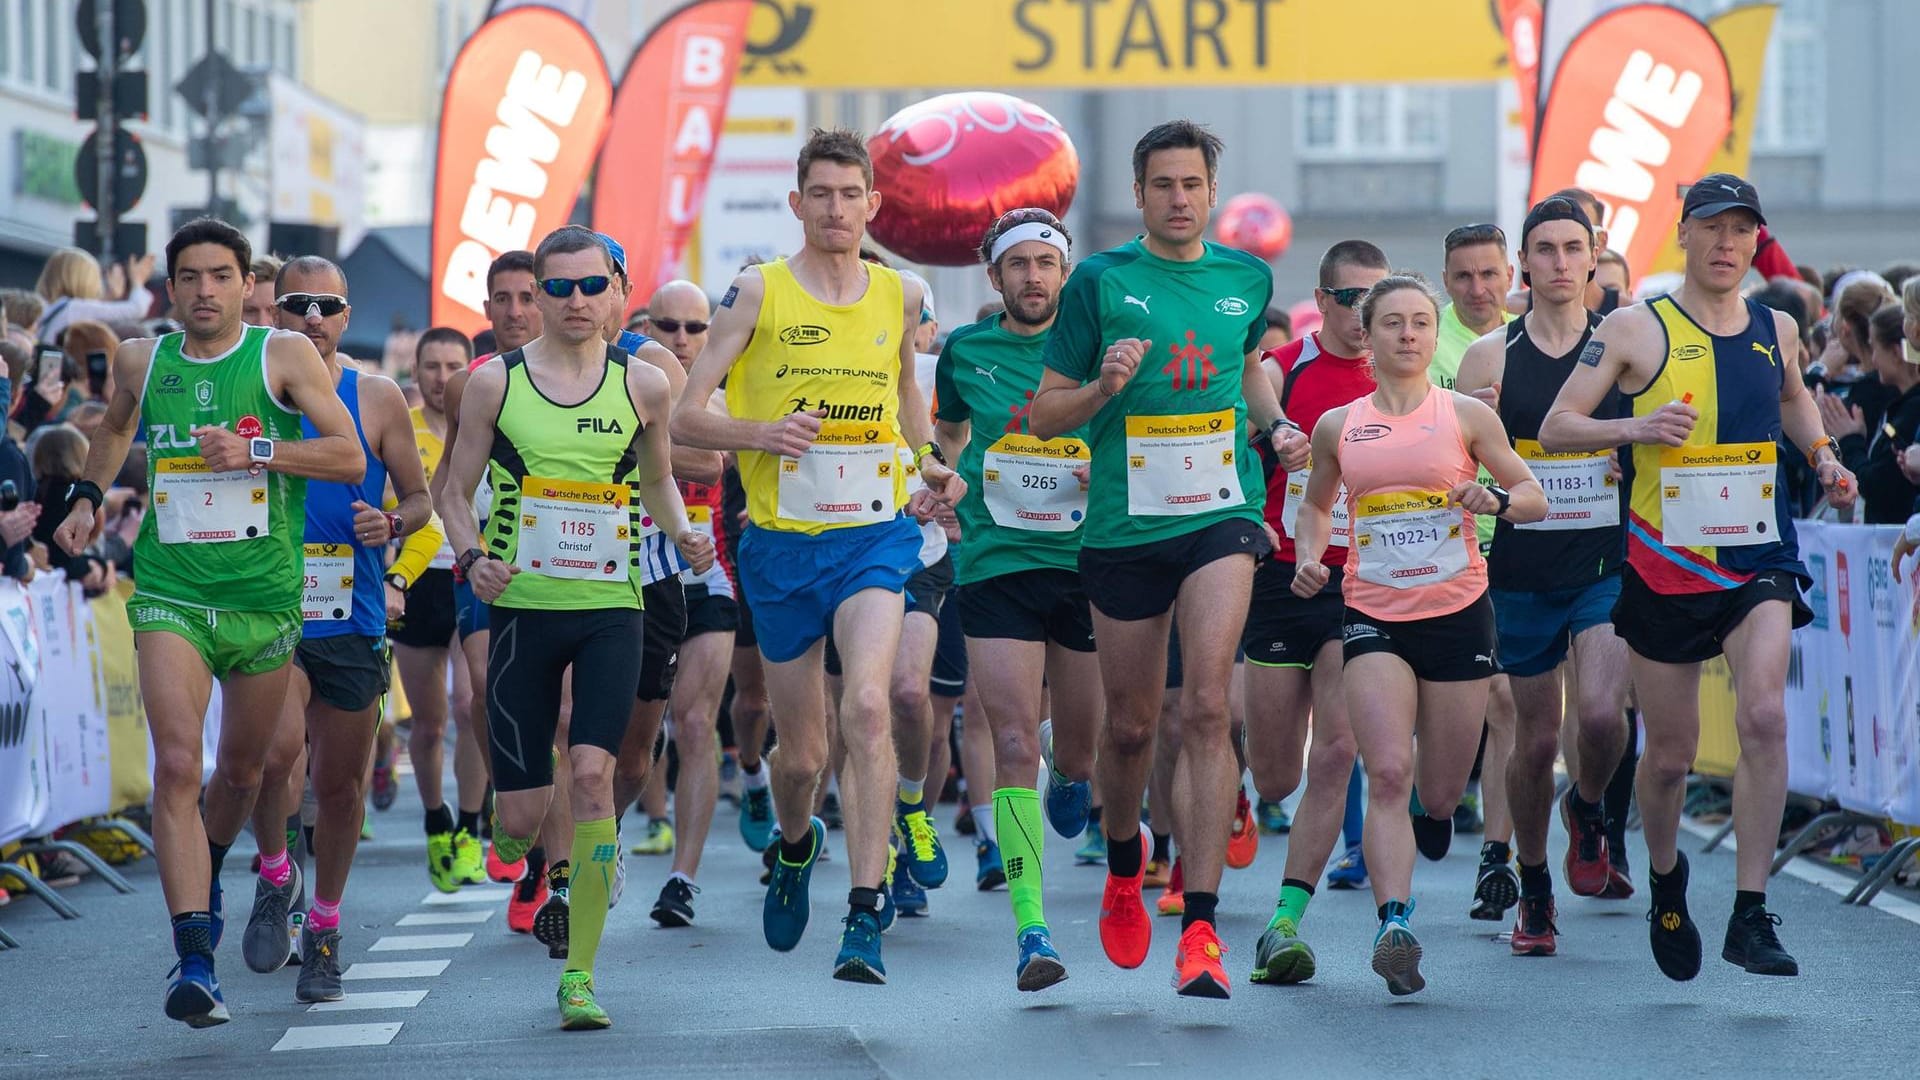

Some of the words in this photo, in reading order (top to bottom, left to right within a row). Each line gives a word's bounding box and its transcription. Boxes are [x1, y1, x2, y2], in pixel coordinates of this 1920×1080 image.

[1012, 0, 1284, 70] START
[791, 368, 888, 380] FRONTRUNNER
[818, 400, 884, 421] bunert
[577, 418, 623, 434] FILA
[1147, 425, 1187, 434] Deutsche
[1188, 424, 1206, 432] Post
[816, 433, 842, 441] utsche
[1004, 443, 1041, 454] Deutsche
[1043, 446, 1061, 455] Post
[1184, 456, 1193, 470] 5
[1682, 455, 1723, 464] Deutsche
[1724, 454, 1743, 462] Post
[169, 462, 206, 470] Deutsche
[838, 465, 844, 479] 1
[1021, 474, 1057, 490] 9265
[1540, 475, 1593, 491] 11183-1
[204, 492, 213, 506] 2
[543, 488, 580, 499] Dtsche
[583, 491, 600, 501] Post
[1173, 493, 1210, 504] BAUHAUS
[1577, 491, 1614, 504] Bornheim
[1720, 486, 1729, 500] 4
[823, 503, 861, 511] BAUHAUS
[1368, 502, 1405, 513] Deutsche
[1406, 500, 1424, 509] Post
[1022, 511, 1060, 520] BAUHAUS
[1552, 511, 1591, 520] BAUHAUS
[561, 520, 595, 536] 1185
[1708, 525, 1748, 534] BAUHAUS
[192, 530, 236, 540] BAUHAUS
[1381, 528, 1438, 547] 11922-1
[558, 540, 592, 552] Christof
[557, 558, 597, 569] BAUHAUS
[1397, 565, 1438, 577] BAUHAUS
[306, 594, 335, 604] Arroyo
[304, 610, 322, 618] HAUS
